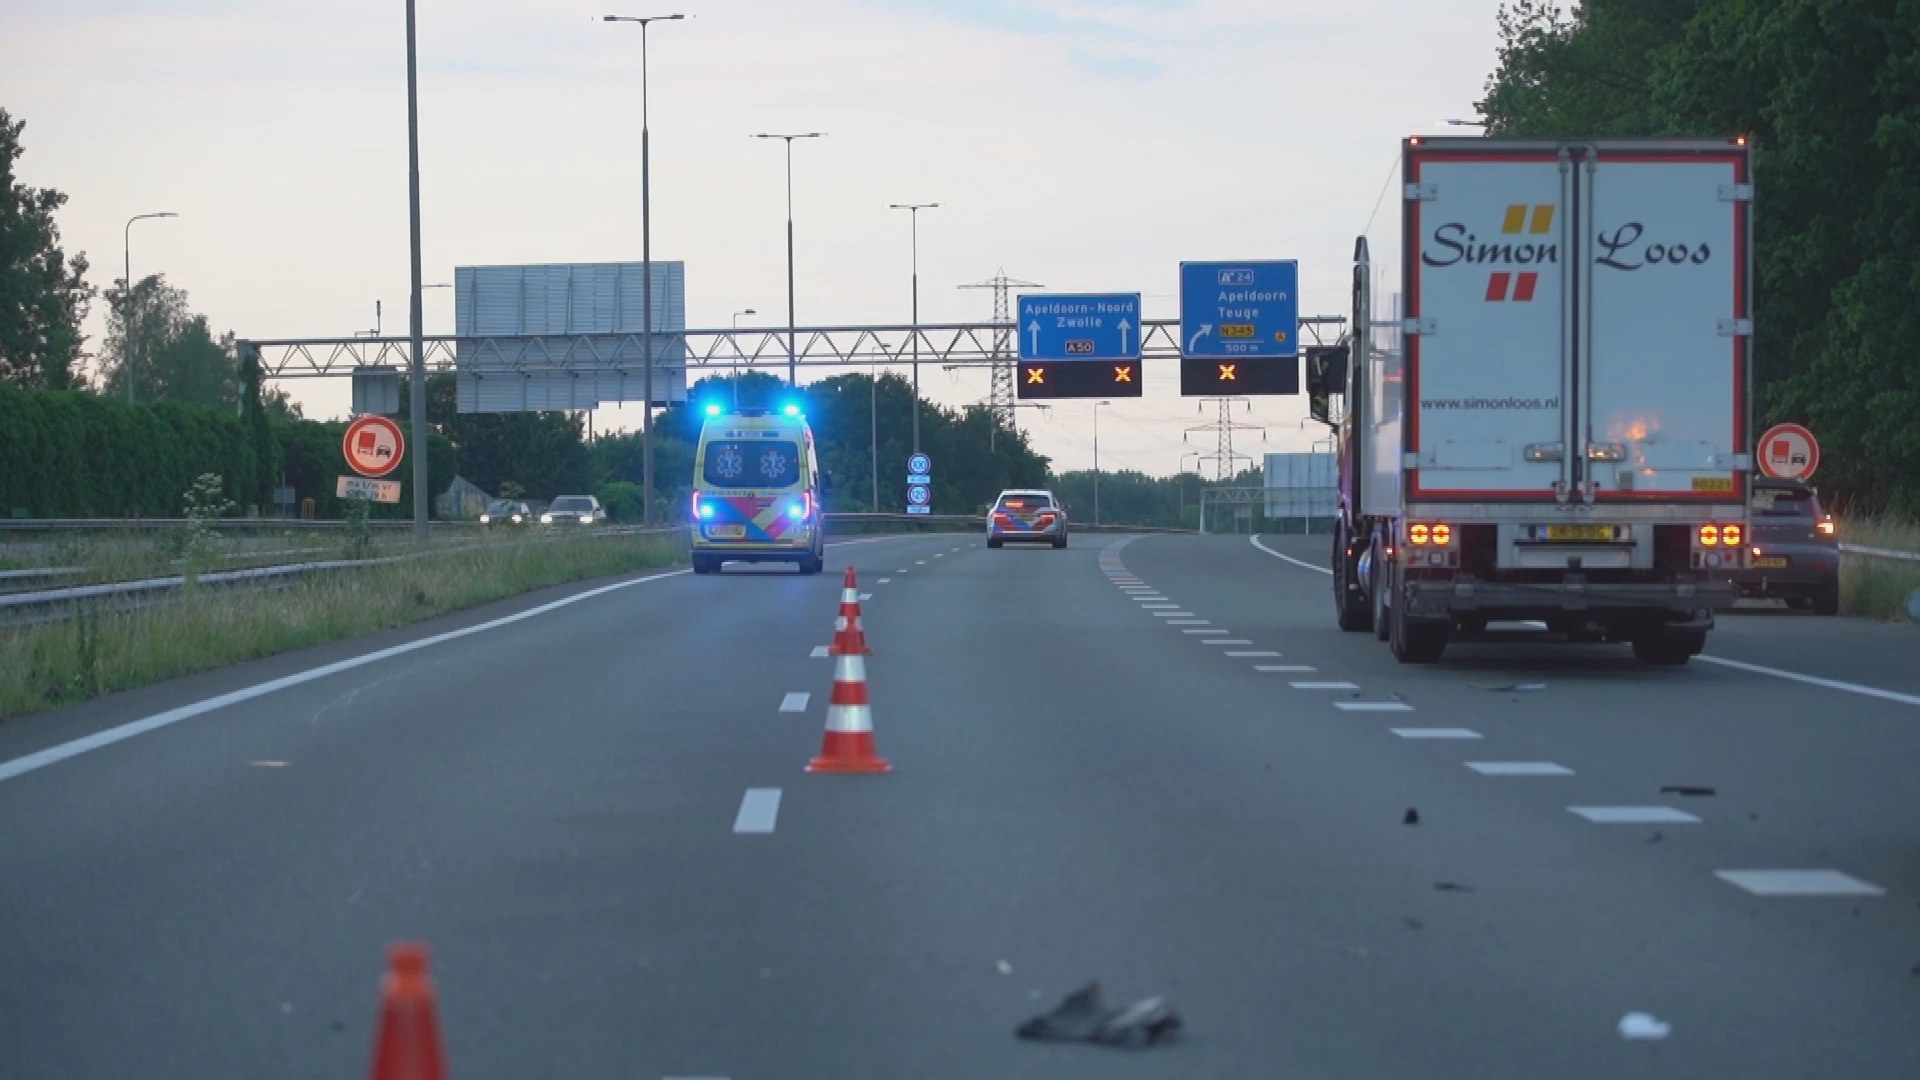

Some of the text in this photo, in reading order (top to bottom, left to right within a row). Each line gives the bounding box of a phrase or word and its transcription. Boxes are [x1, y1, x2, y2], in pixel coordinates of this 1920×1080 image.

[1421, 221, 1711, 271] Simon Loos
[1236, 272, 1251, 282] 24
[1218, 290, 1287, 304] Apeldoorn
[1025, 302, 1134, 315] Apeldoorn-Noord
[1218, 306, 1259, 321] Teuge
[1056, 316, 1103, 328] Zwolle
[1420, 396, 1559, 410] www.simonloos.nl
